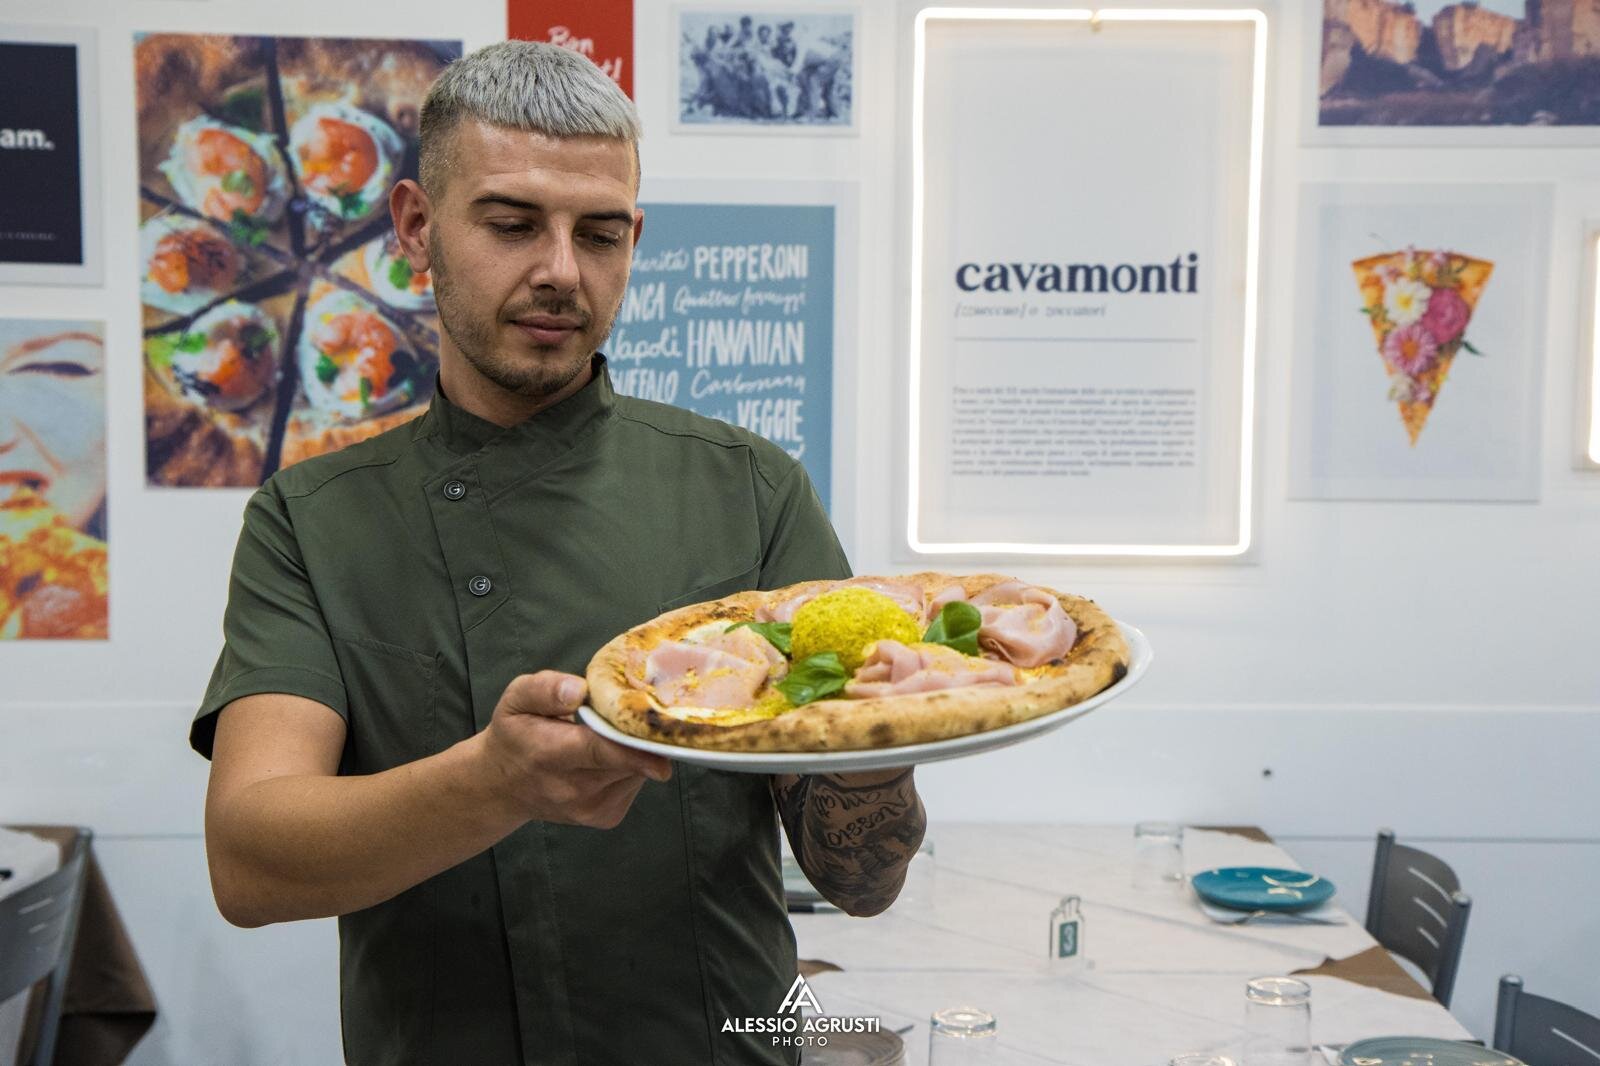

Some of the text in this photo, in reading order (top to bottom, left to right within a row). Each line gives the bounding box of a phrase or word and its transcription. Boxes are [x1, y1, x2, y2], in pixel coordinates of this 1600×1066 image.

[693, 244, 809, 281] PEPPERONI
[955, 252, 1198, 293] cavamonti
[687, 319, 805, 368] HAWAIIAN
[737, 399, 804, 441] VEGGIE
